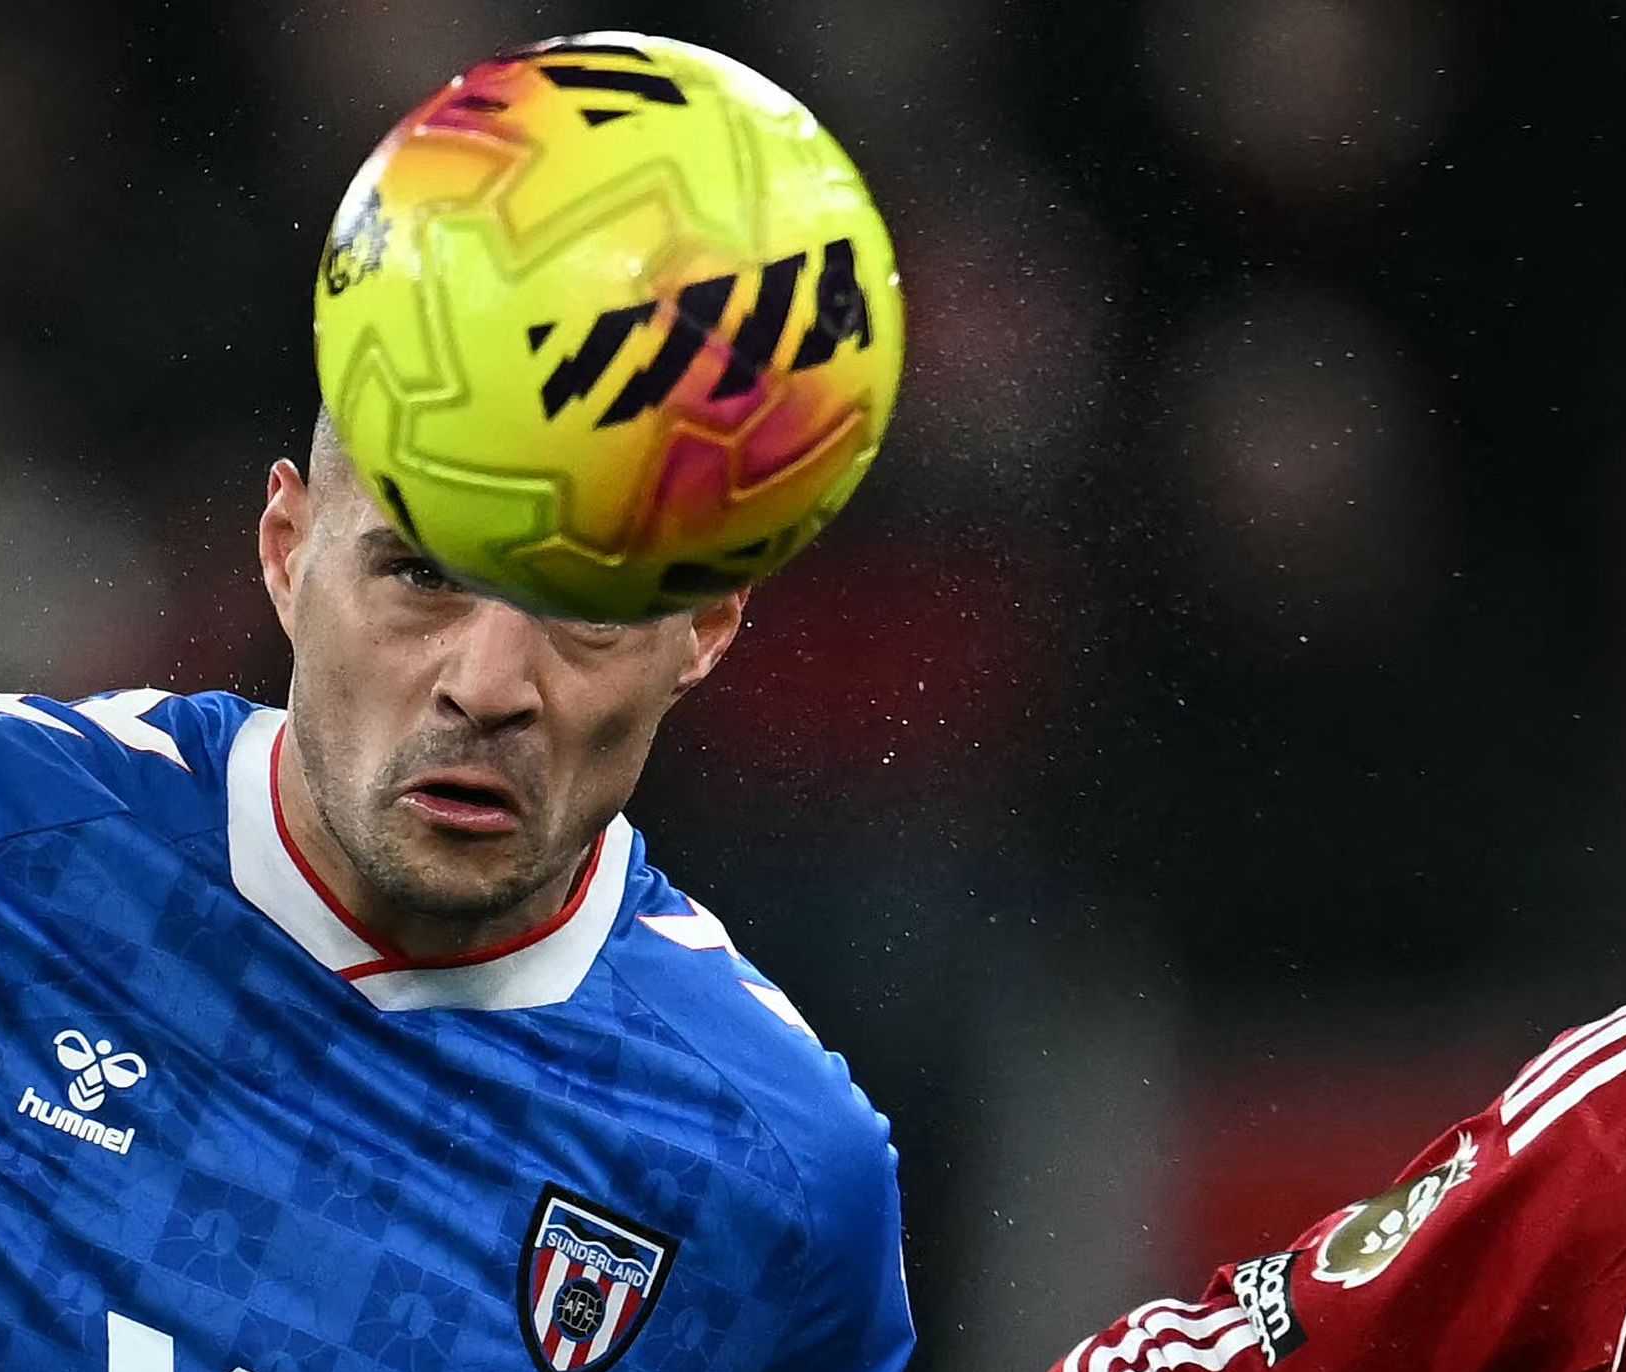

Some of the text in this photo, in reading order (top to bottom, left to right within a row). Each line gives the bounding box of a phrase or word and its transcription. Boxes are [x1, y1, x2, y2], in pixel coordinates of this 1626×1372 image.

[17, 1086, 136, 1155] hummel
[546, 1231, 646, 1288] SUNDERLAND
[563, 1298, 595, 1322] AFC
